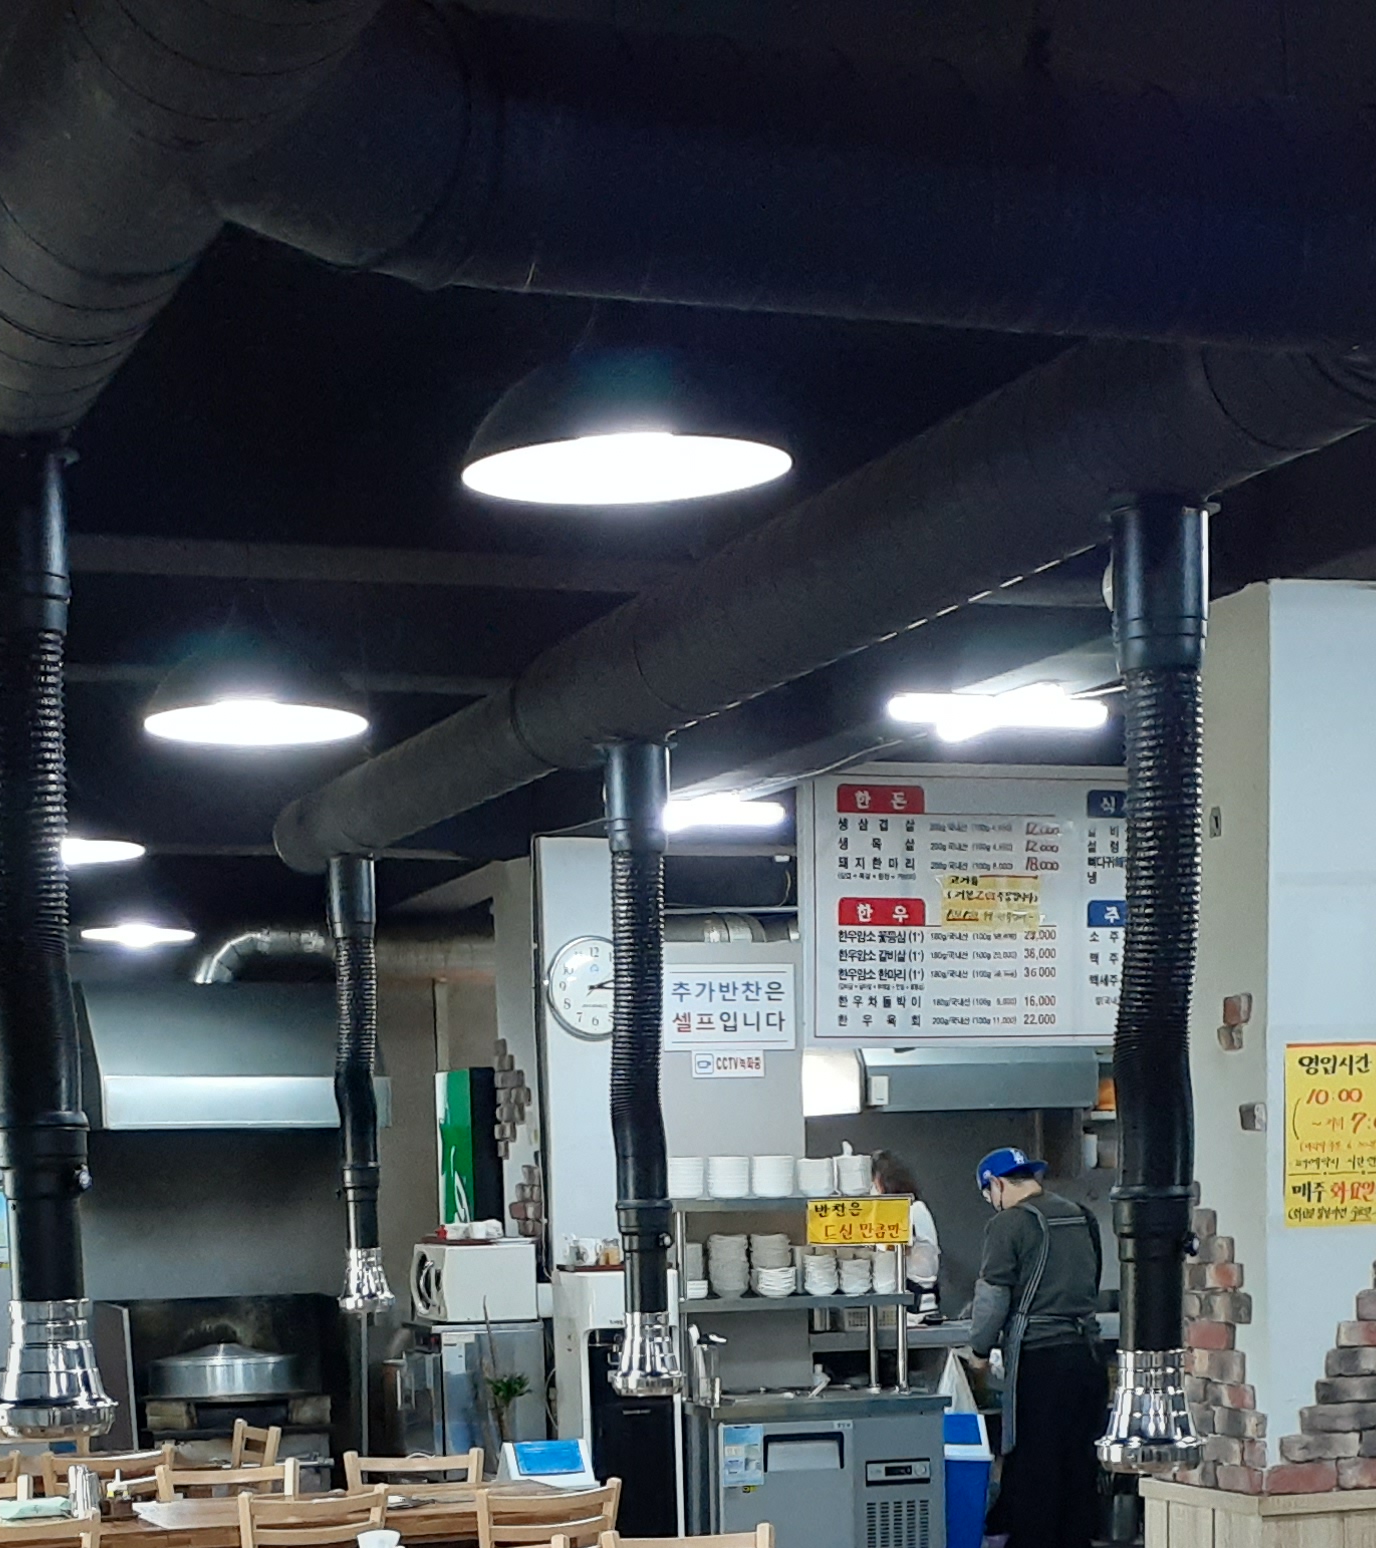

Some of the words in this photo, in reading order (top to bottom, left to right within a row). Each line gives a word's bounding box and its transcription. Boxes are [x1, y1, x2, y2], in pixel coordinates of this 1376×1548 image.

[671, 981, 785, 1003] 추가반찬은
[672, 1010, 786, 1033] 셀프입니다
[1298, 1053, 1372, 1075] 영업시간
[1292, 1181, 1325, 1203] 매주
